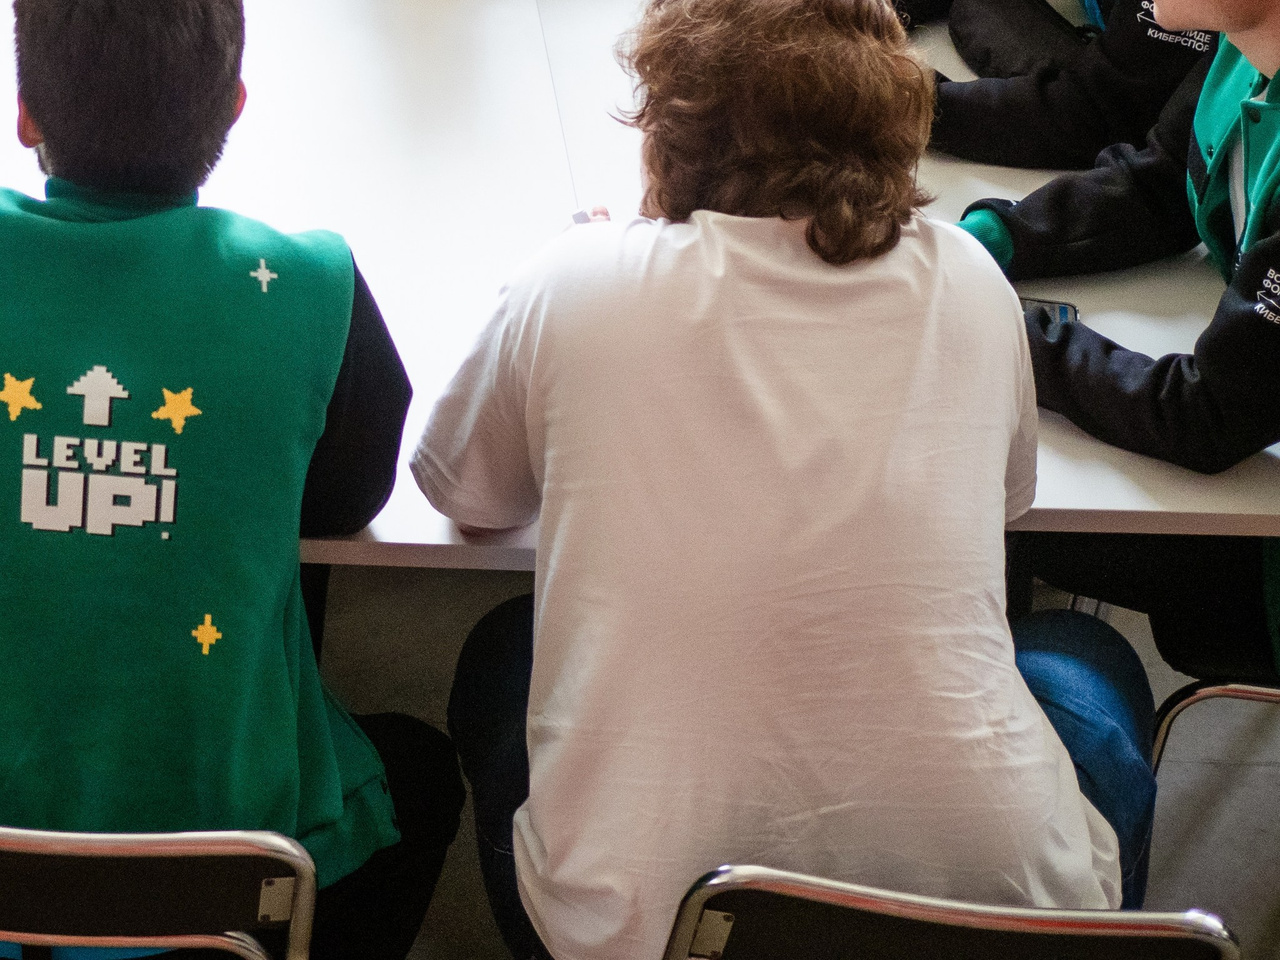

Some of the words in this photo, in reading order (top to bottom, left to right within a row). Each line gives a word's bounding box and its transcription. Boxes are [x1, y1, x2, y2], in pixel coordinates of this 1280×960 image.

[1146, 27, 1210, 52] КИБЕРСПОР
[1180, 29, 1212, 44] ЛИДЕ
[22, 433, 177, 477] LEVEL
[20, 468, 177, 540] UP!
